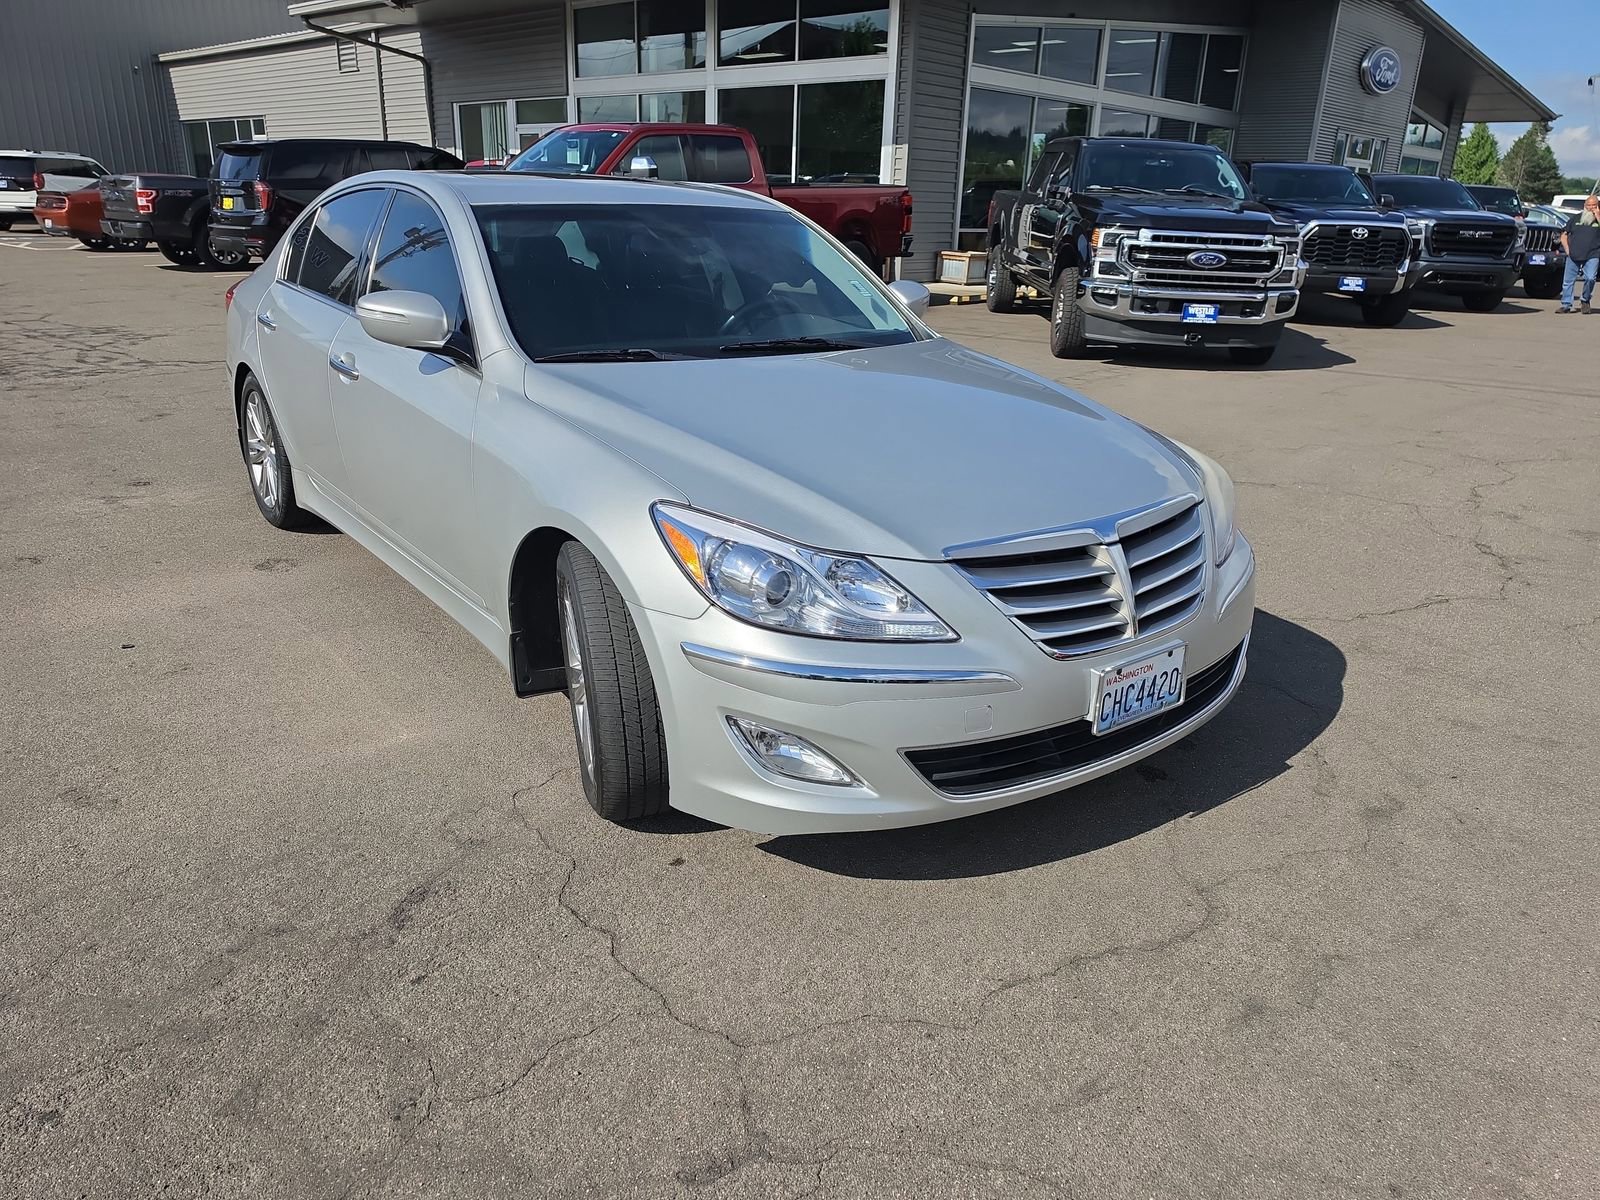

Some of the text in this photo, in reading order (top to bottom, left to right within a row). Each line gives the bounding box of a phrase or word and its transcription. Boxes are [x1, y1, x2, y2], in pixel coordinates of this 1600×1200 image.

[1376, 56, 1397, 85] Ford
[1199, 255, 1219, 265] Ford
[1106, 663, 1154, 687] WASHINGTON
[1101, 667, 1180, 722] CHC4420
